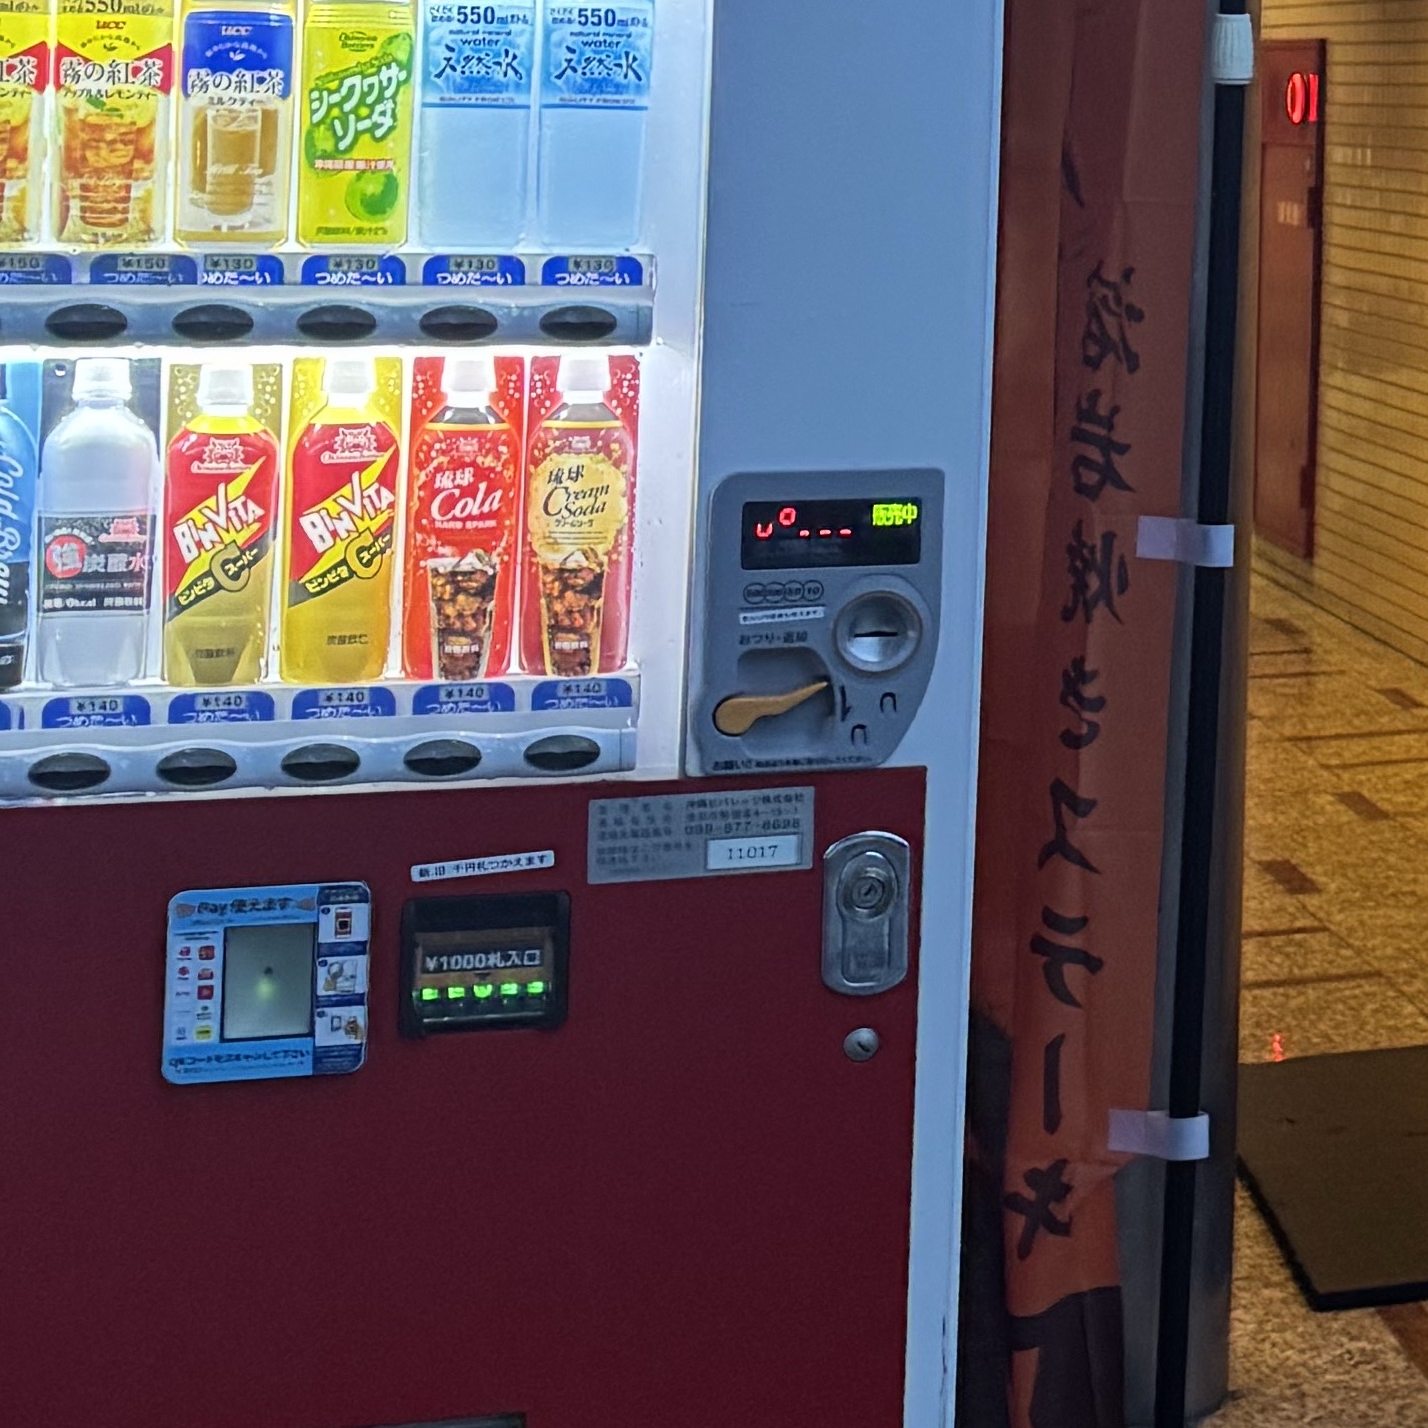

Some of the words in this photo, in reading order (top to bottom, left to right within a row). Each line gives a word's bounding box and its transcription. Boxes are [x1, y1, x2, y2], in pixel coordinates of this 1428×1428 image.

[460, 37, 501, 49] water
[580, 38, 622, 51] water
[433, 43, 523, 81] 天然水
[554, 44, 643, 82] 天然水
[62, 59, 162, 86] 霧の紅茶
[188, 69, 283, 95] 霧の紅茶
[208, 96, 264, 107] ミルクティー
[334, 99, 394, 151] ソーダ
[122, 257, 166, 270] ¥150
[210, 257, 254, 270] ¥130
[332, 258, 376, 271] ¥130
[453, 259, 496, 271] ¥130
[315, 271, 393, 285] つめた〜い
[436, 272, 513, 285] つめた〜い
[430, 480, 504, 521] Cola
[542, 483, 610, 518] Cream
[298, 470, 395, 554] BINVITA
[561, 496, 607, 520] Soda
[172, 481, 266, 565] BINVITA
[443, 686, 485, 699] ¥140
[562, 682, 603, 695] ¥140
[201, 695, 243, 708] ¥140
[322, 690, 365, 703] ¥140
[76, 699, 118, 712] ¥140
[727, 844, 779, 860] 11017
[424, 949, 541, 972] ¥1000札入口
